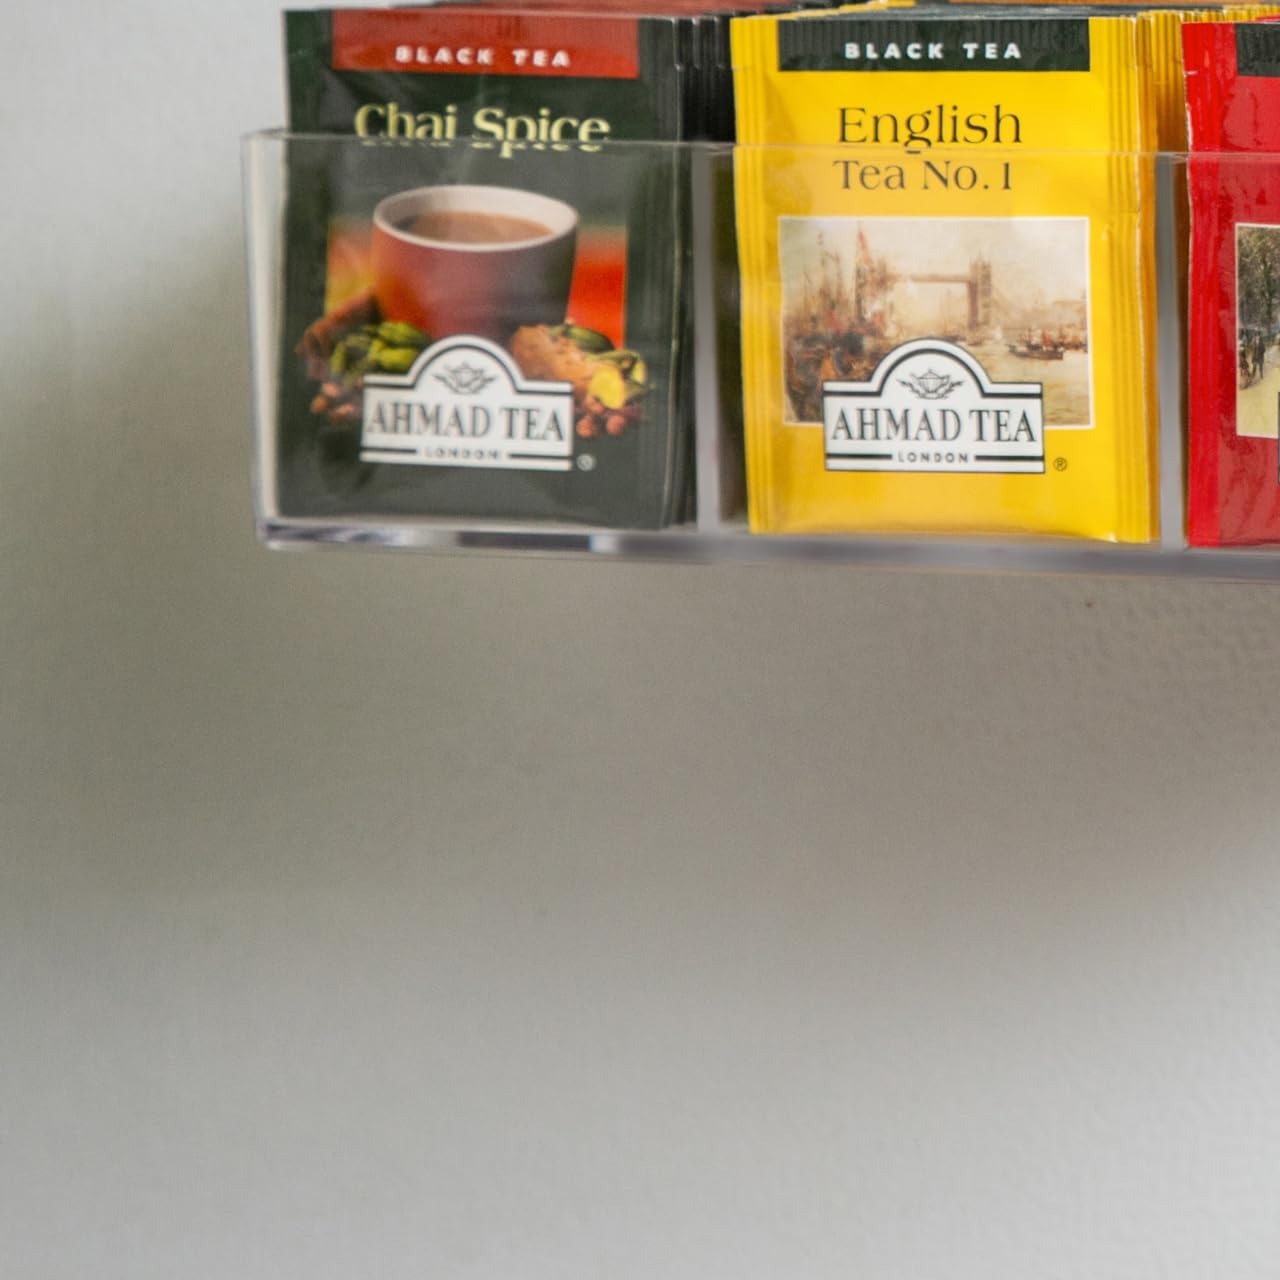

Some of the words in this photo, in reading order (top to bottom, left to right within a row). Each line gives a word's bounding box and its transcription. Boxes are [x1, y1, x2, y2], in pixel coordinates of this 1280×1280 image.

[395, 45, 494, 65] BLACK
[513, 49, 571, 67] TEA
[844, 42, 945, 60] BLACK
[963, 42, 1022, 59] TEA
[355, 102, 458, 146] Chai
[472, 106, 611, 159] Spice
[837, 104, 1023, 154] English
[834, 160, 905, 191] Tea
[367, 403, 489, 439] AHMAD
[501, 407, 565, 443] TEA
[832, 408, 962, 442] AHMAD
[969, 409, 1037, 443] TEA
[424, 447, 502, 462] LONDON
[895, 451, 970, 463] LONDON
